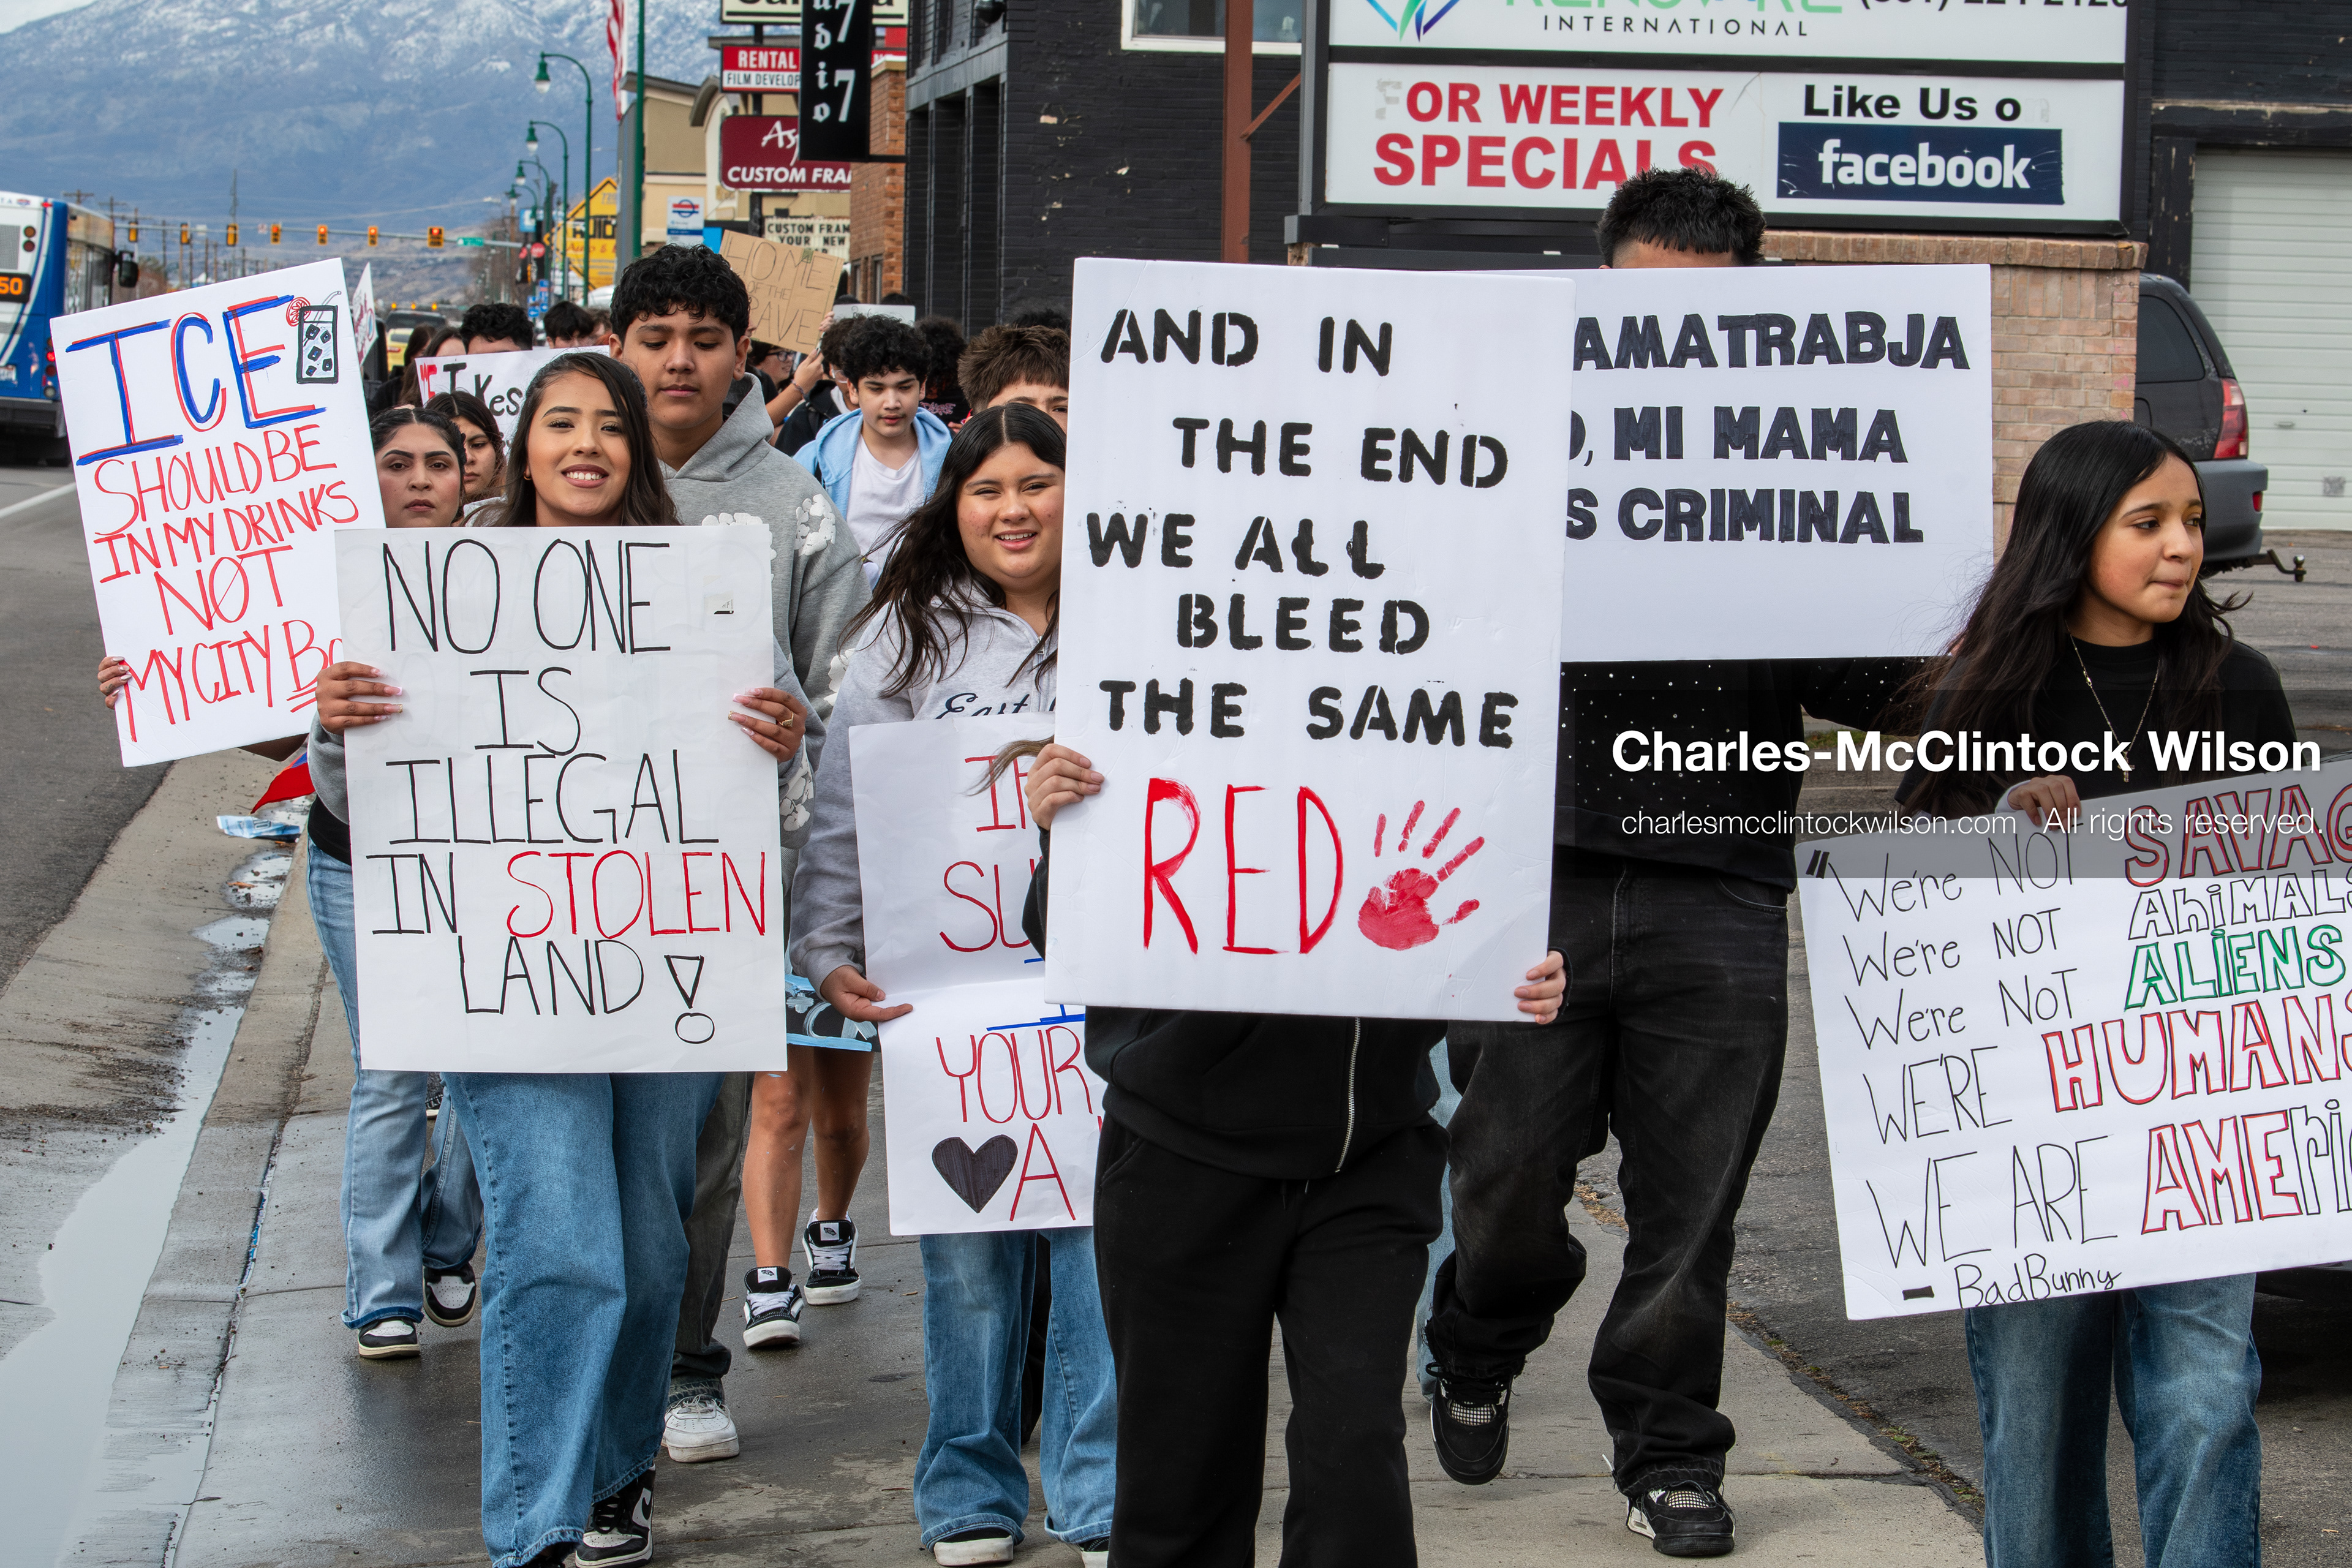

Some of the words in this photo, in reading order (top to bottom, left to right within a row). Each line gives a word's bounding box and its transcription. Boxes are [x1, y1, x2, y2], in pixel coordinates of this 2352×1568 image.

[726, 72, 752, 86] FILM
[738, 50, 797, 69] RENTAL
[1499, 83, 1725, 129] WEEKLY
[1804, 84, 1901, 119] Like
[1920, 87, 1979, 122] Us
[727, 166, 807, 184] CUSTOM
[812, 167, 852, 184] FRA
[1818, 138, 2032, 189] facebook
[767, 223, 814, 234] CUSTOM
[779, 235, 810, 246] YOUR
[823, 236, 846, 246] NEW
[747, 280, 765, 294] OF
[768, 284, 792, 300] THE
[1100, 307, 1259, 368] AND
[1317, 316, 1393, 377] IN
[65, 294, 327, 466] ICE
[1172, 417, 1314, 477] THE
[1360, 426, 1509, 489] END
[1613, 405, 1684, 462] MI
[1713, 405, 1909, 464] MAMA
[94, 440, 263, 536] SHOULD
[263, 424, 337, 483] BE
[1618, 486, 1924, 545] CRIMINAL
[93, 527, 162, 583] IN
[163, 512, 215, 567] MY
[222, 480, 360, 551] DRINKS
[1087, 511, 1196, 569] WE
[1234, 516, 1385, 580] ALL
[154, 545, 293, 636] NOT
[383, 538, 501, 654] NO
[533, 538, 671, 655] ONE
[1177, 592, 1430, 655] BLEED
[119, 647, 191, 743] MY
[191, 624, 274, 709] CITY
[469, 665, 582, 757] IS
[1099, 677, 1248, 739] THE
[1306, 684, 1520, 749] SAME
[385, 748, 719, 845] ILLEGAL
[365, 852, 458, 935] IN
[507, 849, 766, 939] STOLEN
[1143, 775, 1344, 956] RED
[1988, 823, 2084, 896] NOT
[939, 856, 1044, 952] SU
[1842, 930, 1962, 987] We're
[1992, 907, 2062, 960] NOT
[1843, 987, 1966, 1050] We're
[935, 1025, 1094, 1125] YOUR
[1862, 1045, 2013, 1145] WE'RE
[2040, 986, 2352, 1114] HUMAN
[1009, 1122, 1076, 1222] A
[1865, 1151, 1992, 1269] WE
[2012, 1134, 2118, 1250] ARE
[2140, 1099, 2352, 1235] AMEri
